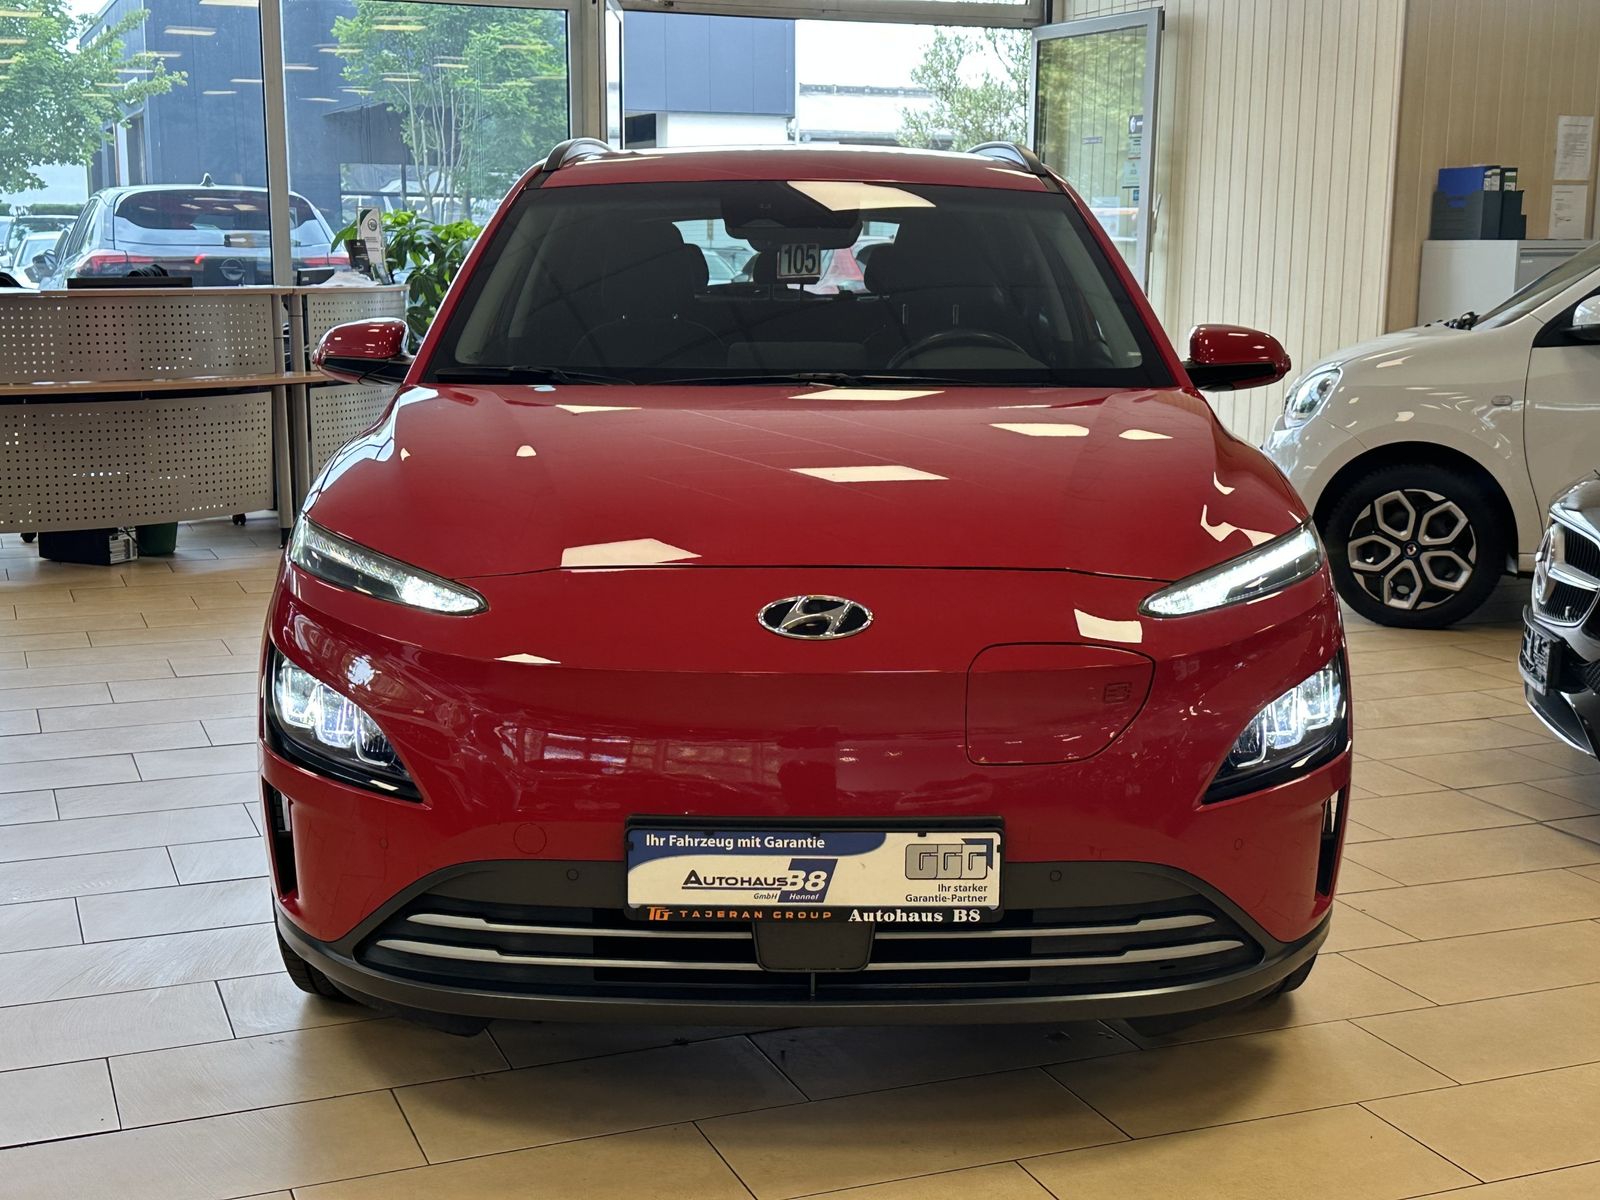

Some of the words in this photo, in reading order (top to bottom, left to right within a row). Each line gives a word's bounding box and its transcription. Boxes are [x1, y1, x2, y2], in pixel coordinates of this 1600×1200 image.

[784, 243, 817, 279] 105
[646, 834, 665, 847] Ihr
[669, 834, 734, 850] Fahrzeug
[737, 837, 761, 848] mit
[764, 836, 825, 849] Garantie
[937, 884, 951, 893] Ihr
[953, 884, 988, 893] starker
[753, 892, 778, 900] GmbH
[905, 894, 988, 903] Garantie-Partner
[680, 910, 763, 919] TAJERAN
[773, 911, 832, 919] GROUP
[848, 908, 943, 922] Autohaus
[953, 908, 981, 922] B8
